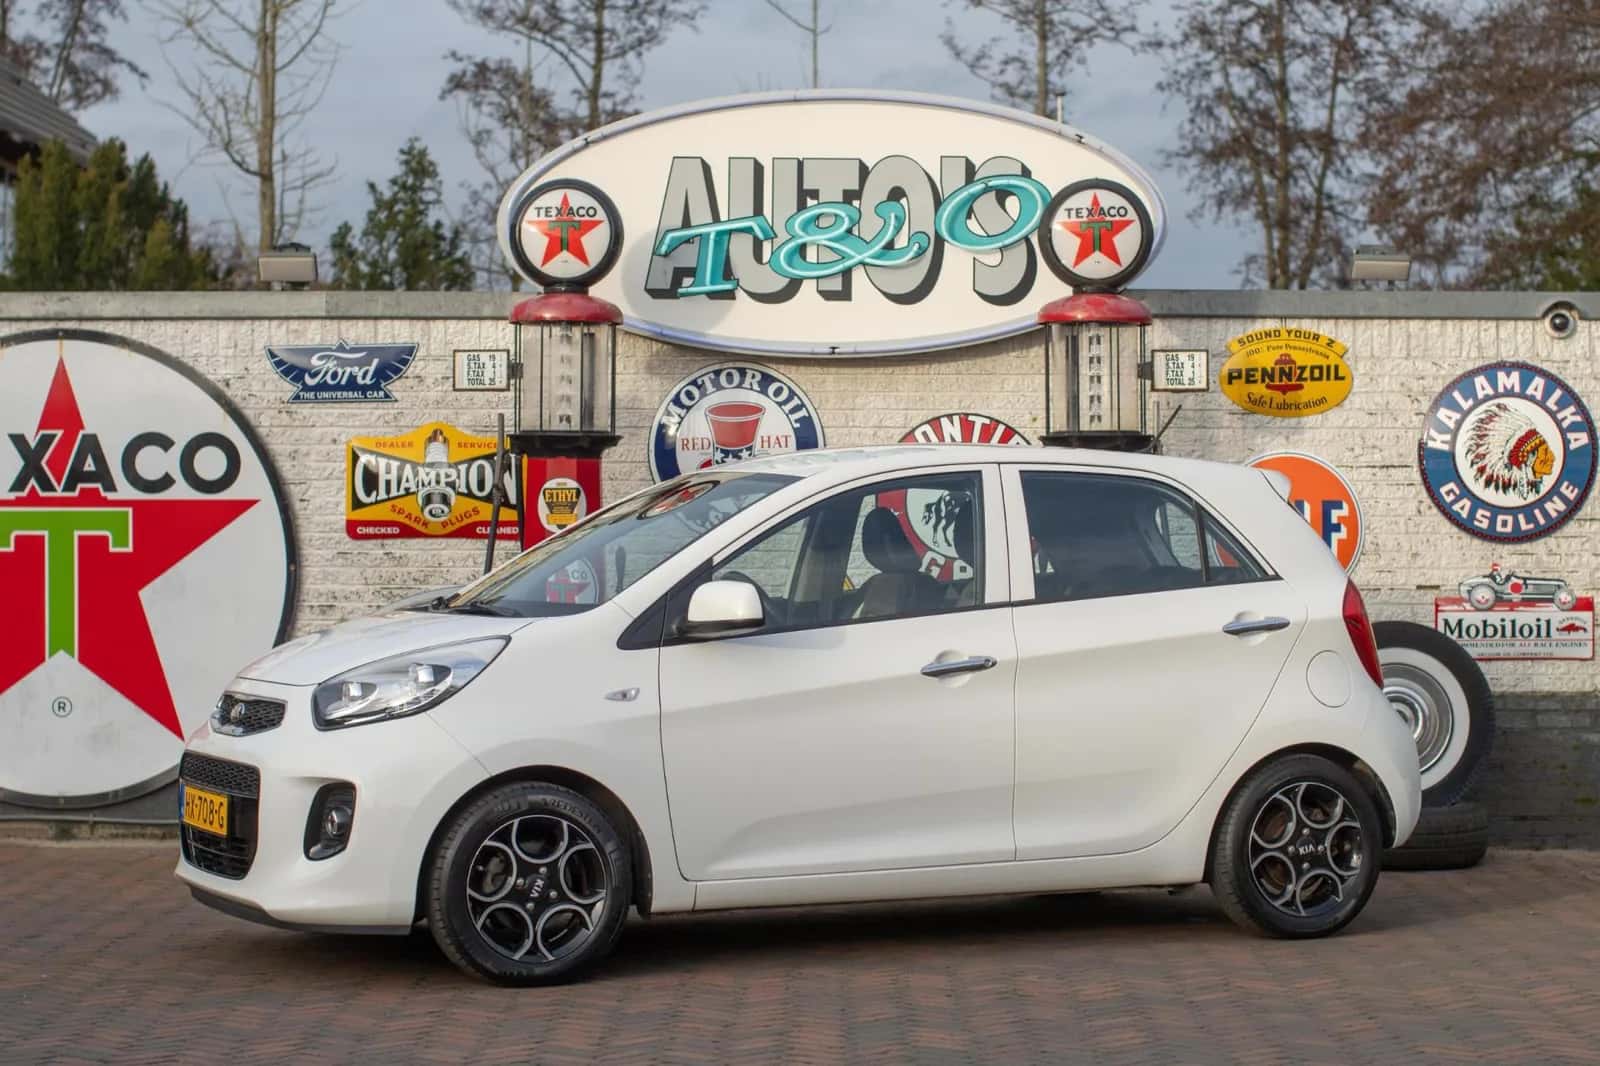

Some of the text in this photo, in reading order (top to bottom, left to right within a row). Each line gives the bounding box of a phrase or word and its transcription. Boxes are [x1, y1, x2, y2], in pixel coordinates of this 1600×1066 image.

[534, 206, 597, 218] TEXACO
[1064, 206, 1128, 218] TEXACO
[1238, 329, 1281, 347] SOUND
[1286, 329, 1320, 342] YOUR
[304, 351, 379, 386] Ford
[1227, 364, 1346, 385] PENNZOIL
[317, 391, 364, 399] UNIVERSAL
[660, 368, 810, 436] MOTOR OIL
[1247, 391, 1328, 411] Safe Lubrication
[1427, 371, 1589, 450] KALAMALKA
[375, 441, 414, 449] DEALER
[681, 435, 792, 450] RED HAT
[354, 453, 517, 505] CHAMPION
[544, 489, 577, 502] ETHYL
[389, 503, 481, 529] SPARK PLUGS
[1439, 480, 1579, 533] GASOLINE
[356, 526, 519, 535] CHECKED CLNED
[1443, 617, 1552, 639] Mobiloil
[185, 791, 225, 830] HX-708-G
[1299, 844, 1315, 855] KIA
[530, 879, 545, 898] KIA
